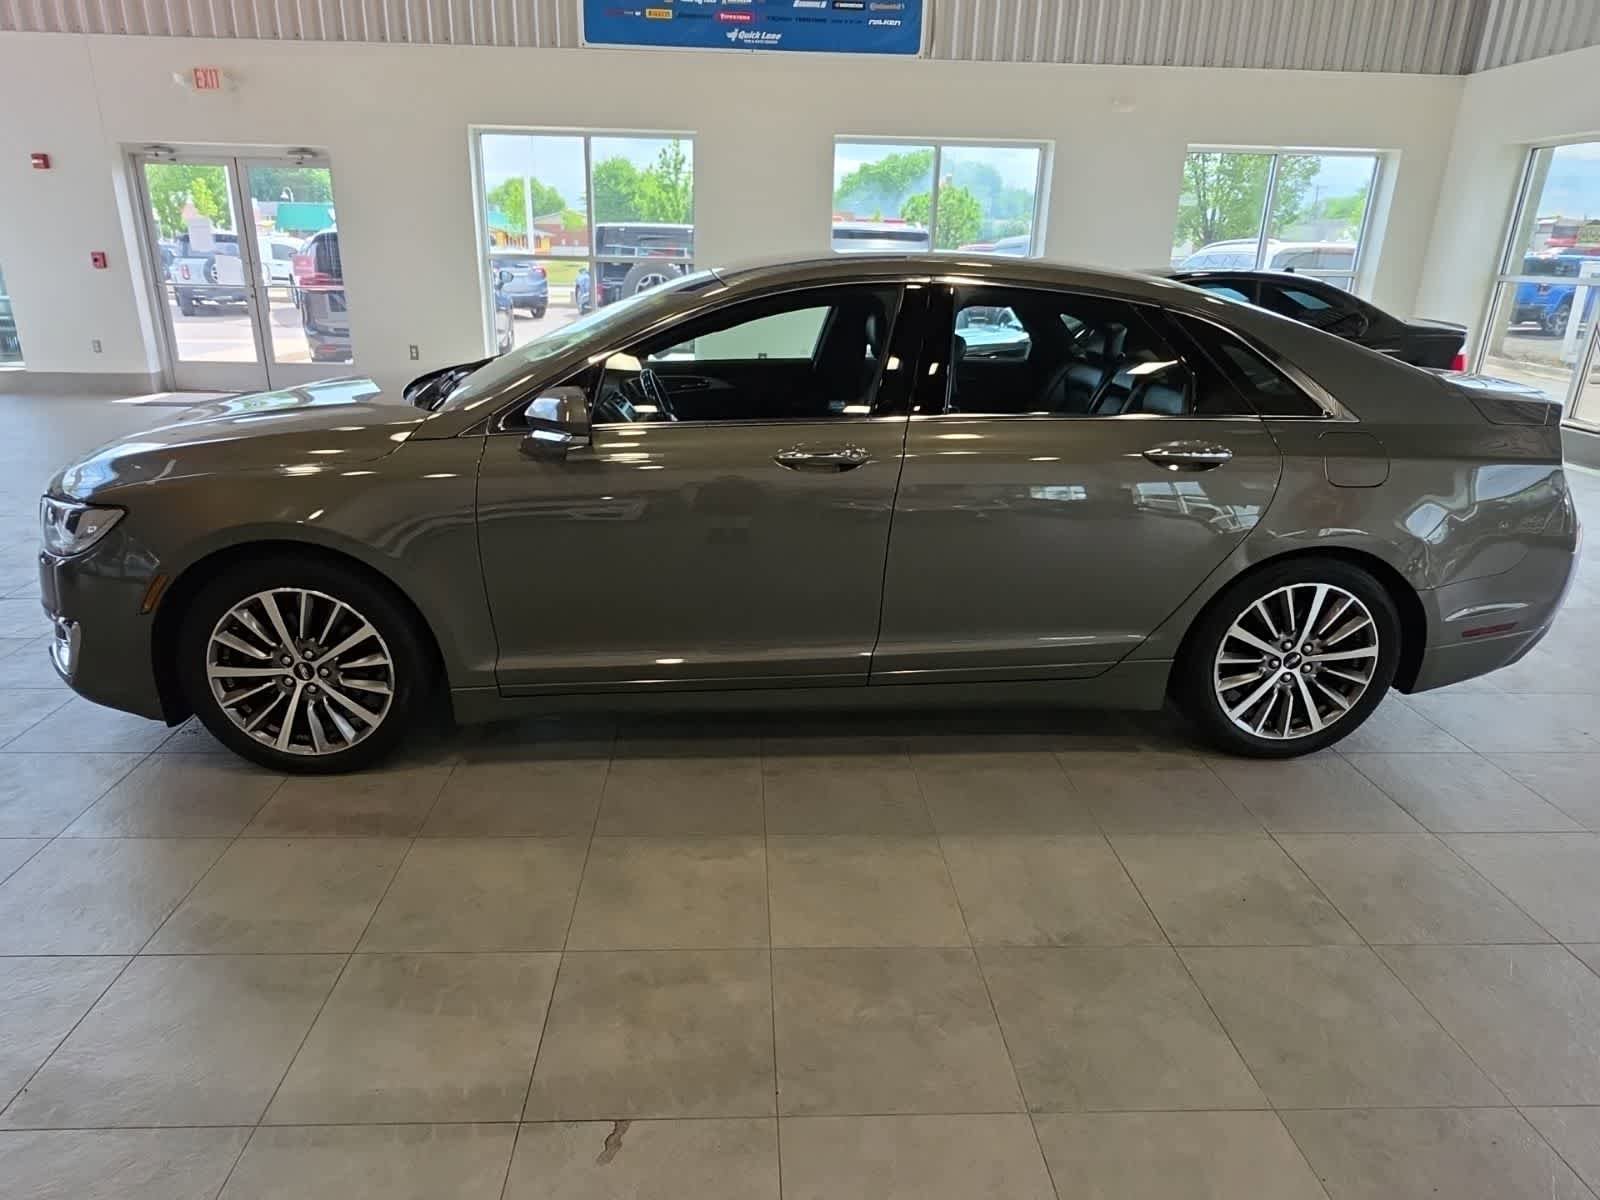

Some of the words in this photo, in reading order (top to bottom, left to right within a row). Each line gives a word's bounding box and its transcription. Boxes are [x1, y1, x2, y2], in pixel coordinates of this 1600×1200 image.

[738, 30, 761, 40] Quick
[761, 31, 782, 40] Lane
[193, 68, 220, 89] EXIT
